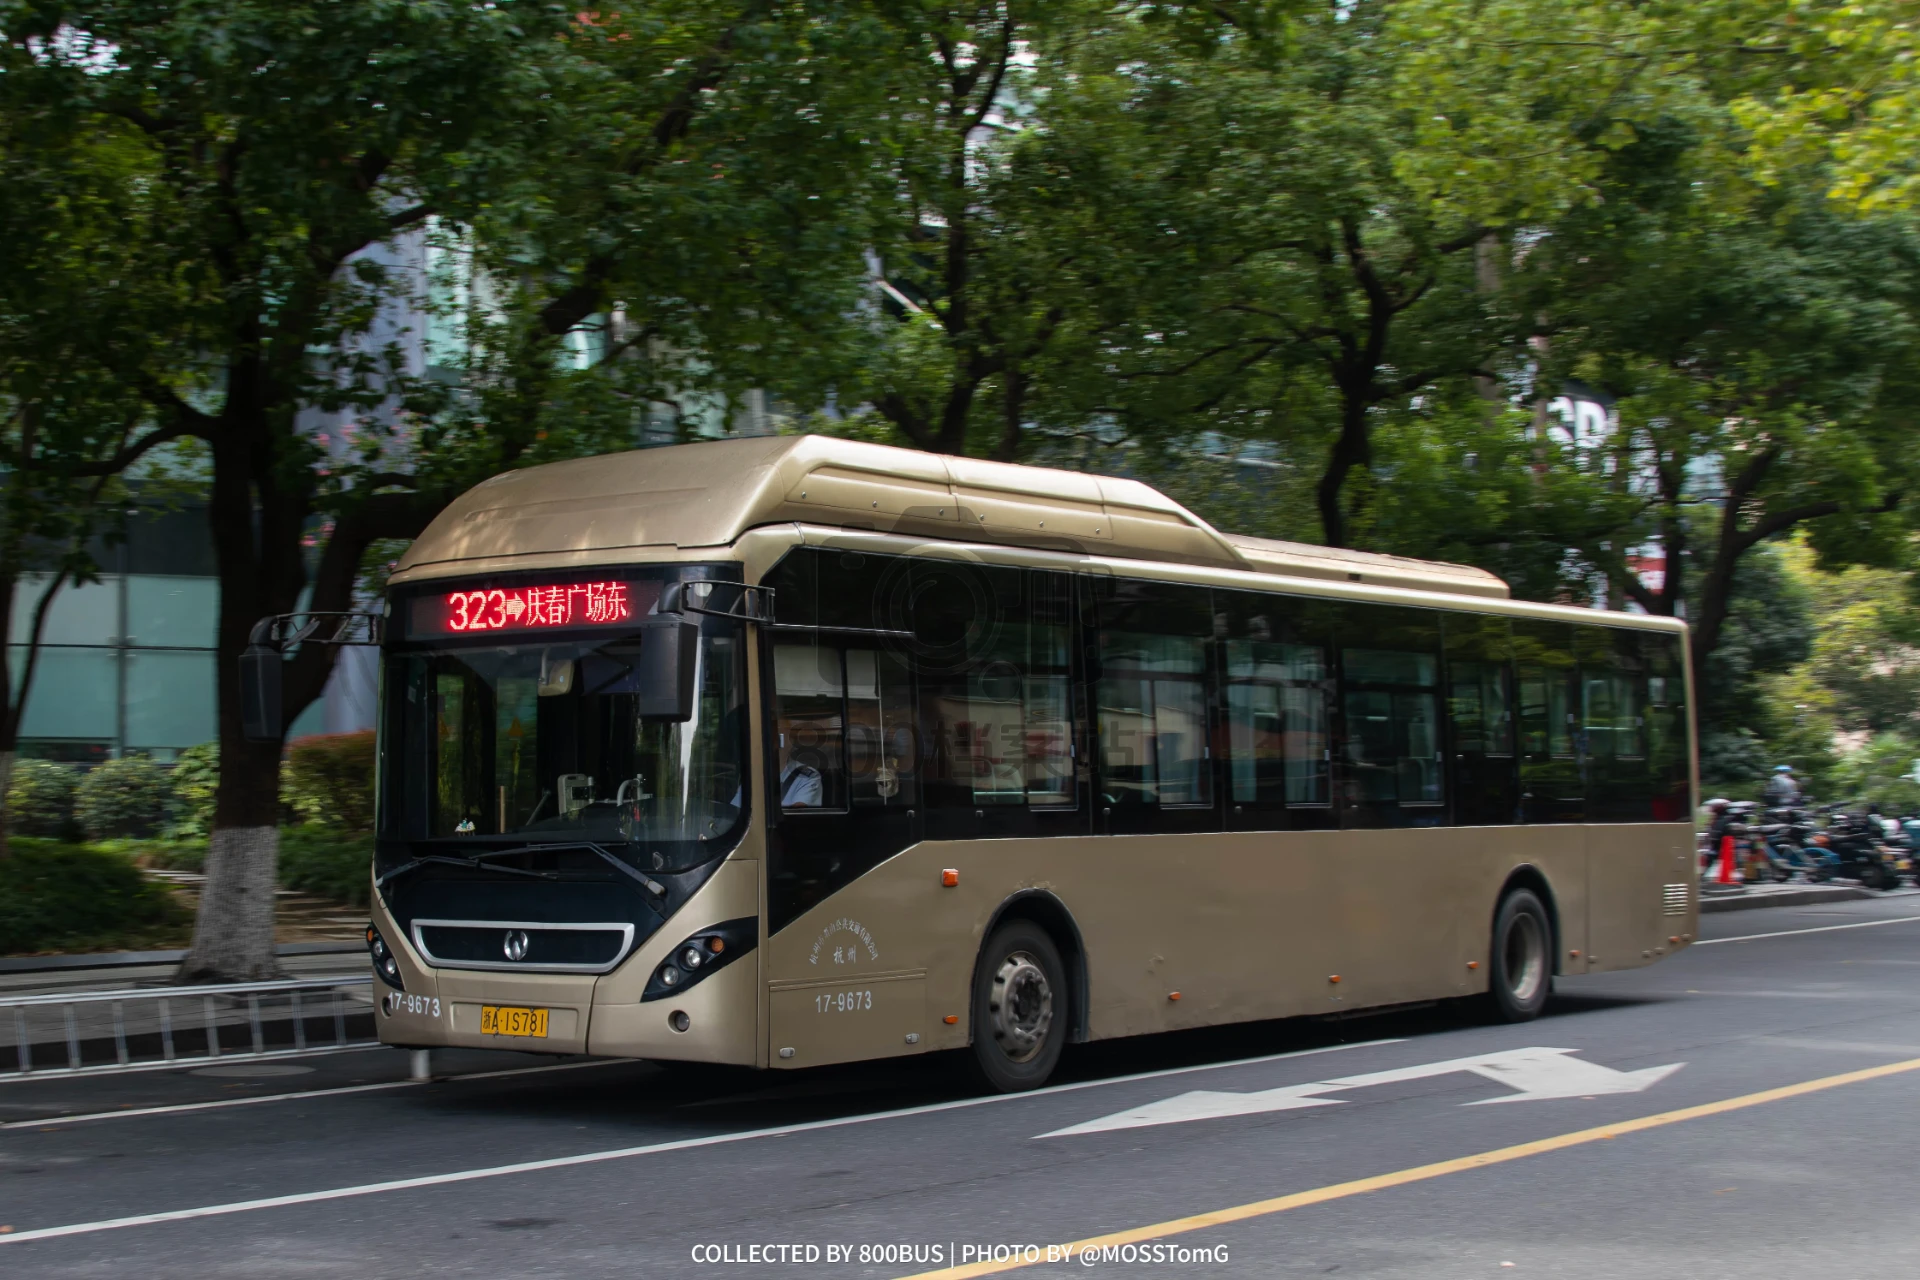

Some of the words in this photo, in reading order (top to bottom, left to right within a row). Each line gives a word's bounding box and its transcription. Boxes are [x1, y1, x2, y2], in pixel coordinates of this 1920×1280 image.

[449, 589, 507, 630] 323
[525, 581, 628, 626] 庆春广场东
[388, 991, 440, 1018] 17-9673
[815, 990, 872, 1013] 17-9673
